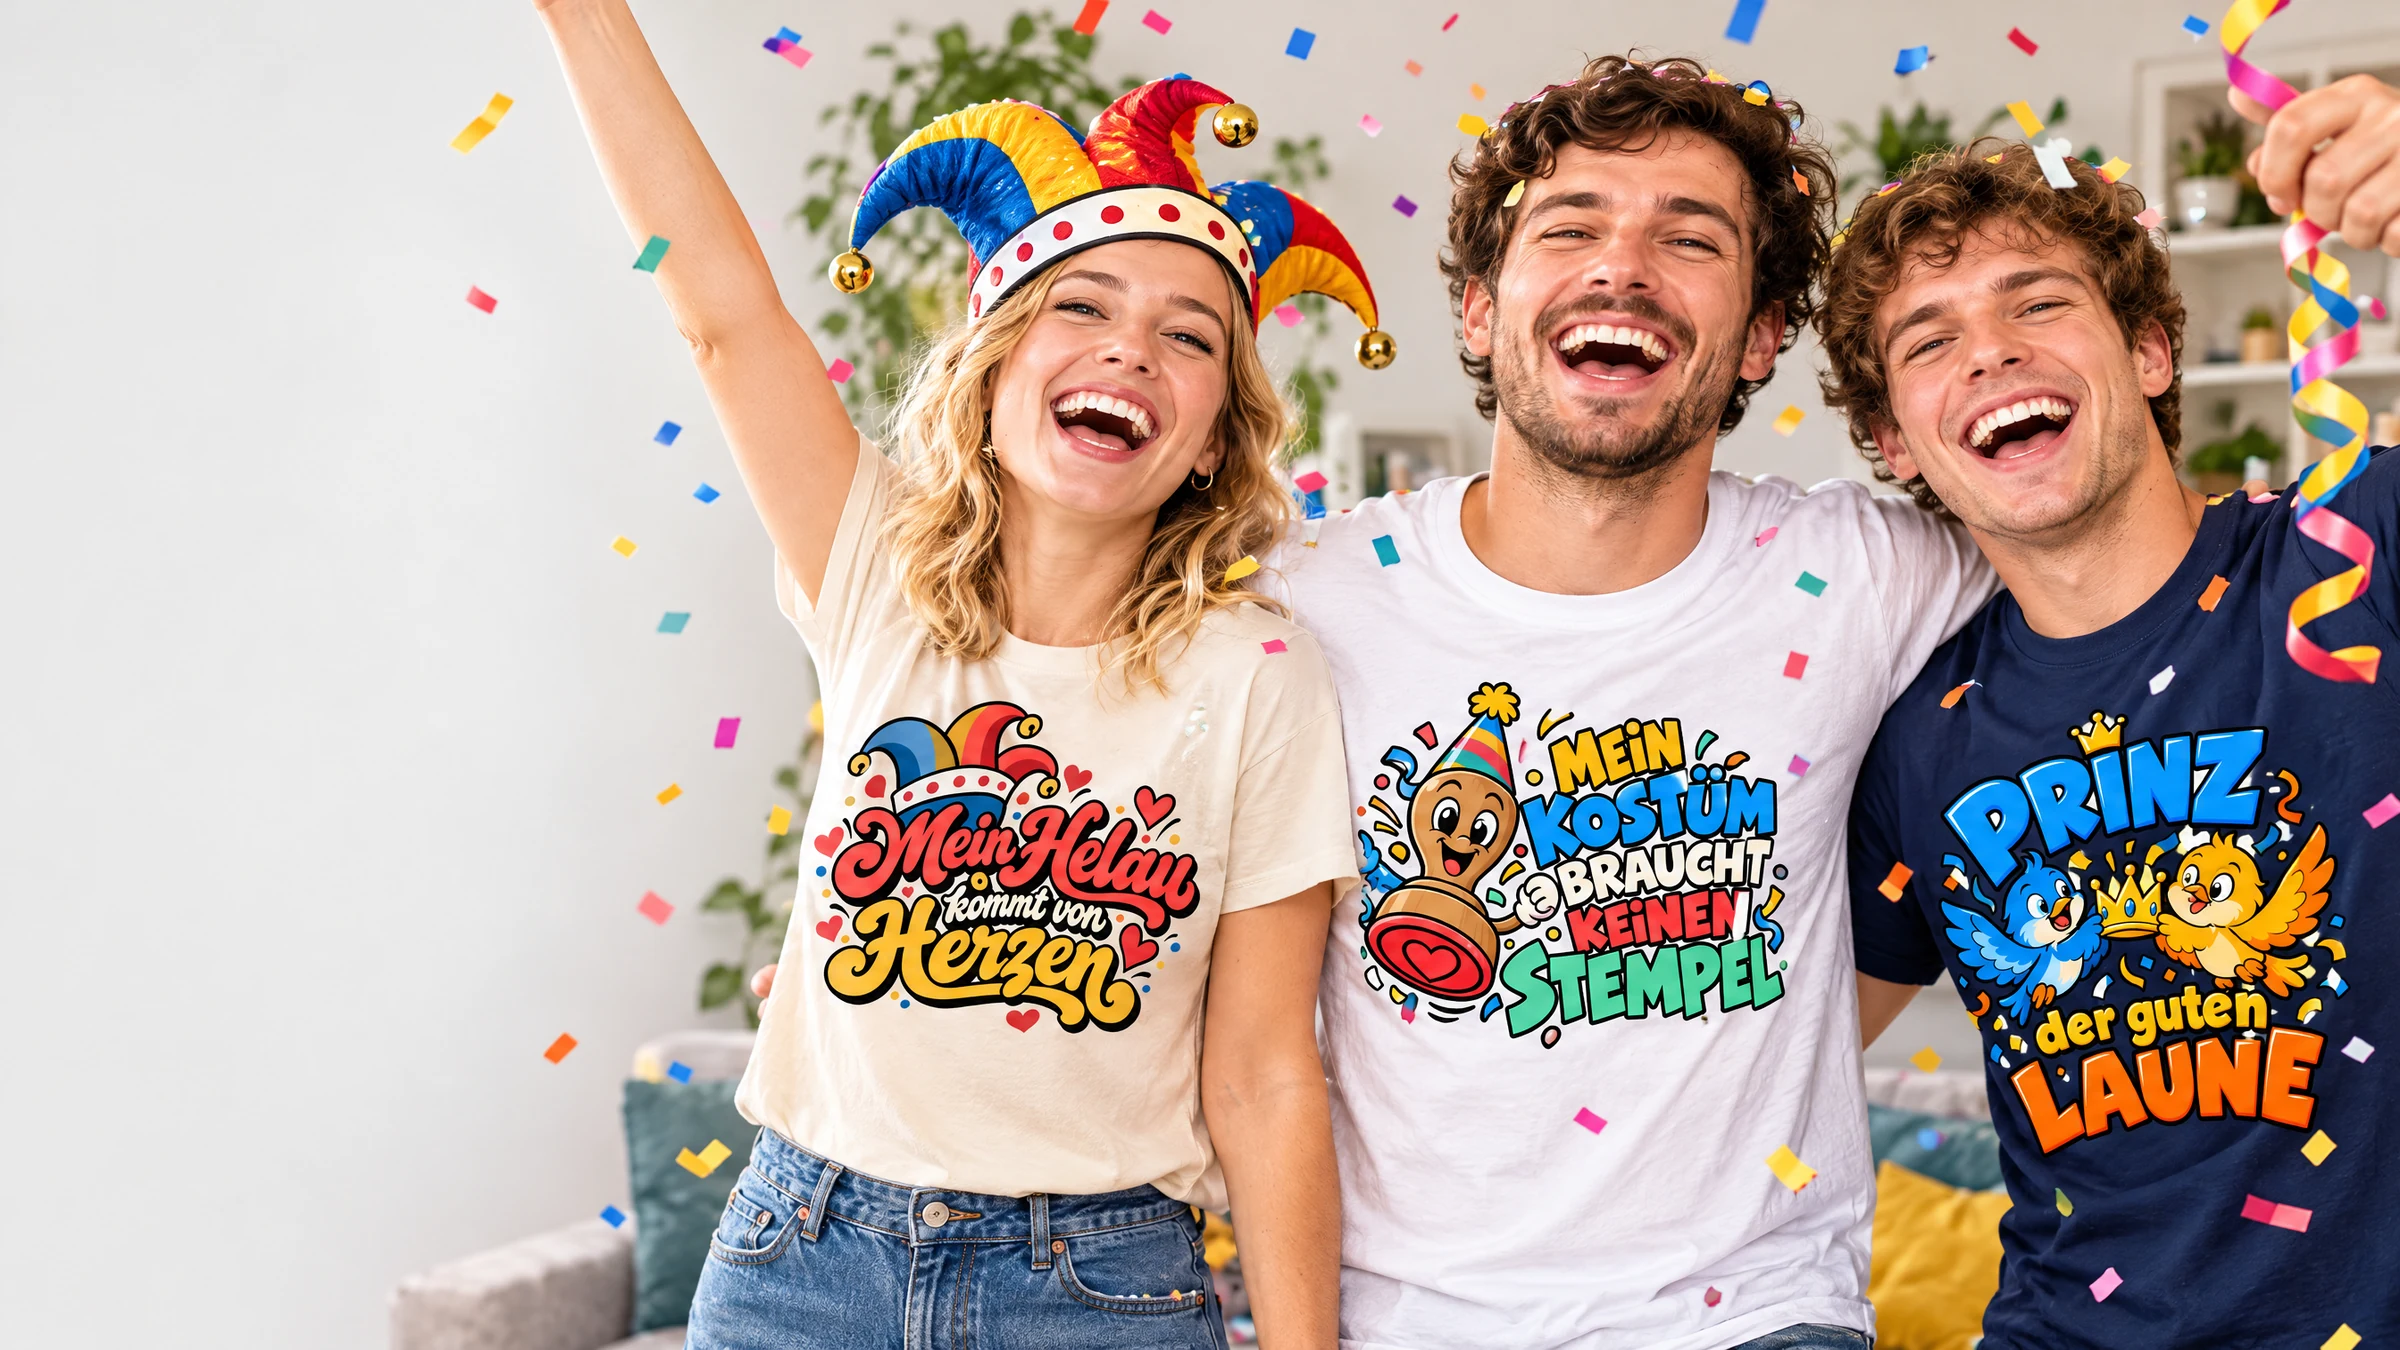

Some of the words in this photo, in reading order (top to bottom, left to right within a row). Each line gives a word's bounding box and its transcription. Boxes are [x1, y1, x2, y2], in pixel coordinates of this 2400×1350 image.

[1521, 765, 1778, 868] KOSTÜM
[832, 801, 1018, 899] Mein
[998, 799, 1200, 936] Helau
[943, 887, 1052, 924] kommt
[1051, 900, 1109, 933] von
[1556, 838, 1774, 903] BRAUCHT
[824, 896, 1141, 1033] Herzen
[1500, 937, 1785, 1037] STEMPEL
[2035, 1004, 2116, 1055] der
[2126, 984, 2269, 1046] guten
[2008, 1027, 2325, 1155] LAUNE
